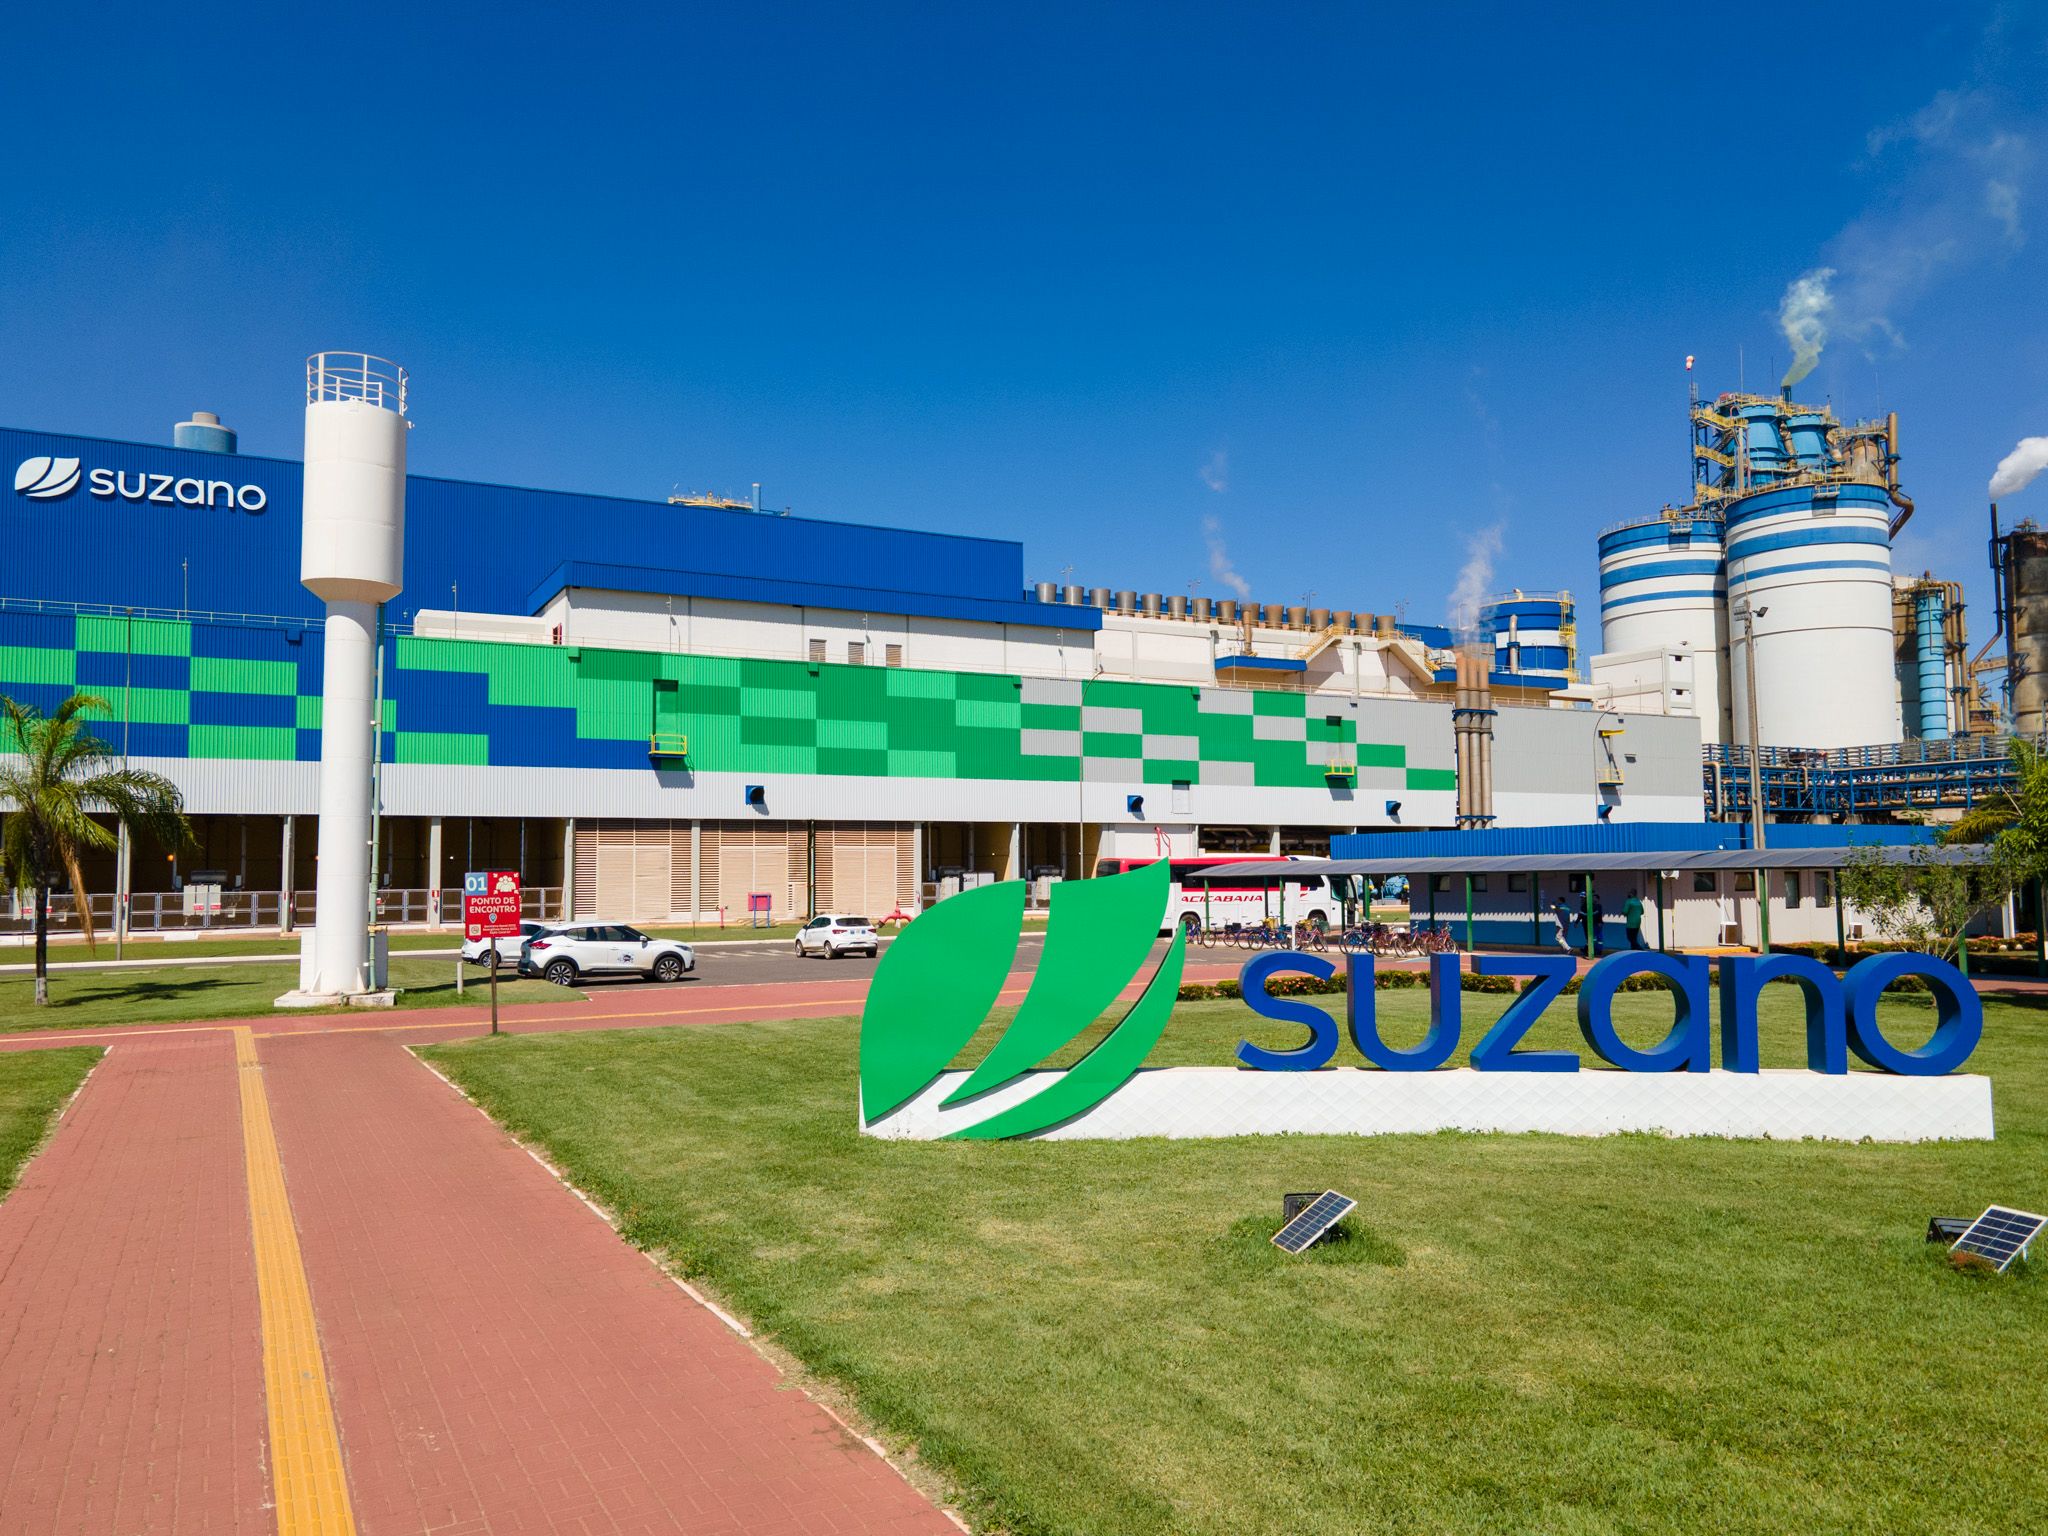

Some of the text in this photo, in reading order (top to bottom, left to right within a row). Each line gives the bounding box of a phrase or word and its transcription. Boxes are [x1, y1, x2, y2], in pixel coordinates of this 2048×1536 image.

[89, 467, 267, 511] suzano
[466, 876, 487, 892] 01
[469, 905, 516, 913] ENCONTRO
[471, 897, 501, 905] PONTO
[1235, 950, 1983, 1077] suzano
